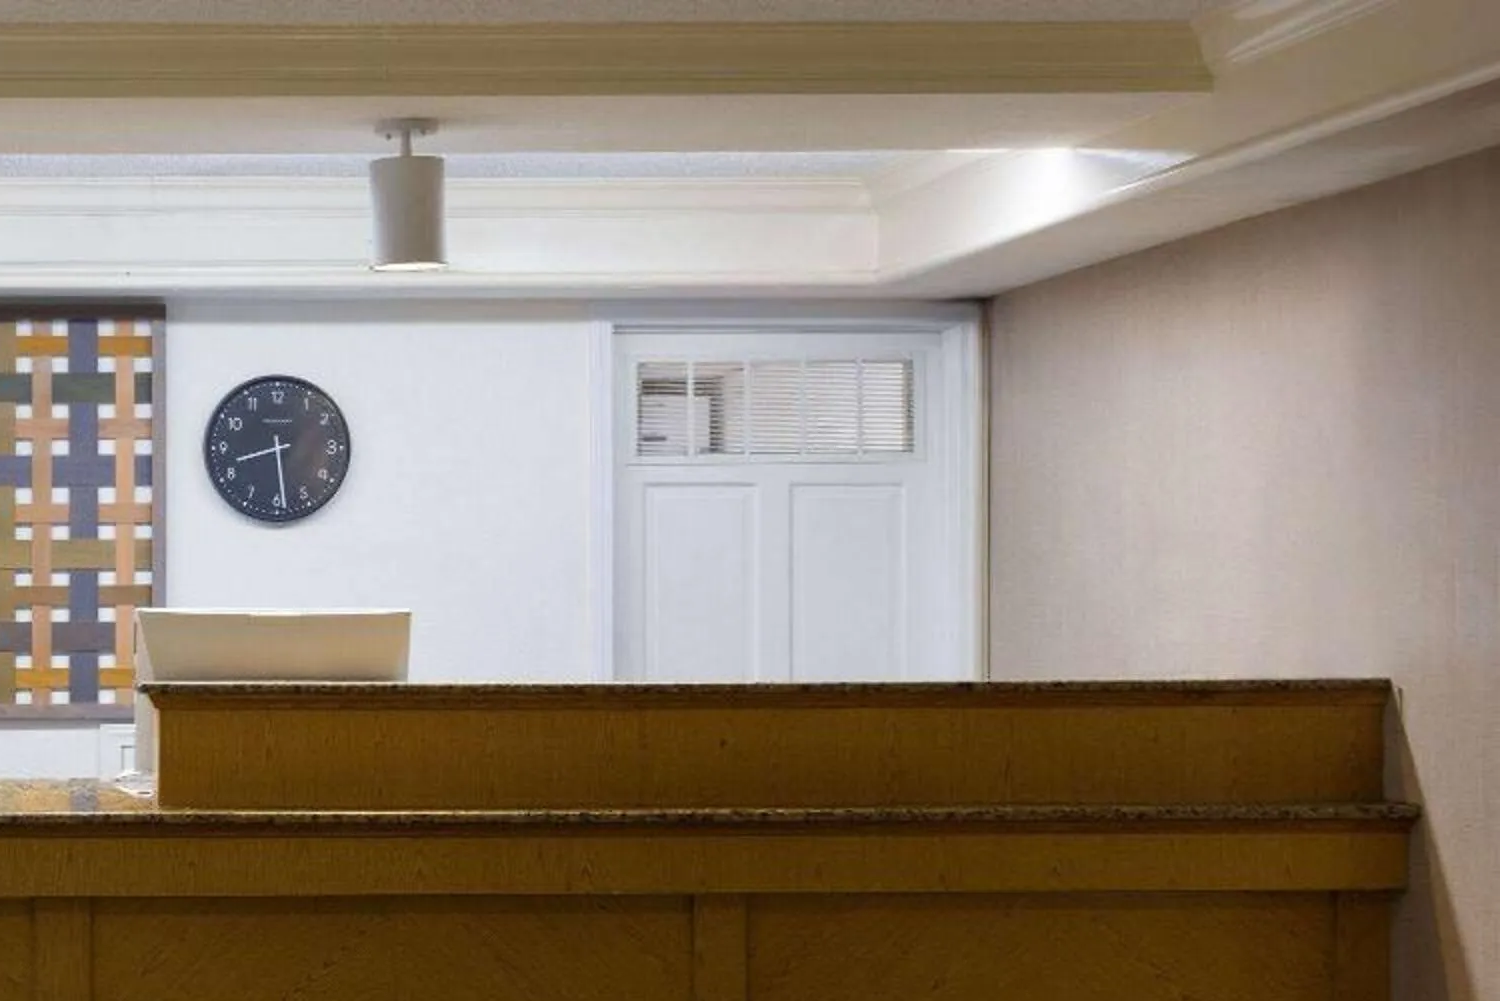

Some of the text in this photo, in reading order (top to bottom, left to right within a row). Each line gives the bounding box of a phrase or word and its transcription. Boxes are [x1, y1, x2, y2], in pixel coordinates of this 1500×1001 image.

[248, 397, 257, 411] 11
[271, 391, 284, 404] 12
[304, 398, 309, 410] 1
[228, 417, 243, 431] 10
[319, 413, 329, 425] 2
[219, 441, 228, 454] 9
[325, 440, 337, 455] 3
[227, 467, 236, 480] 8
[317, 468, 329, 480] 4
[248, 485, 255, 498] 7
[300, 486, 308, 499] 5
[273, 494, 280, 507] 6
